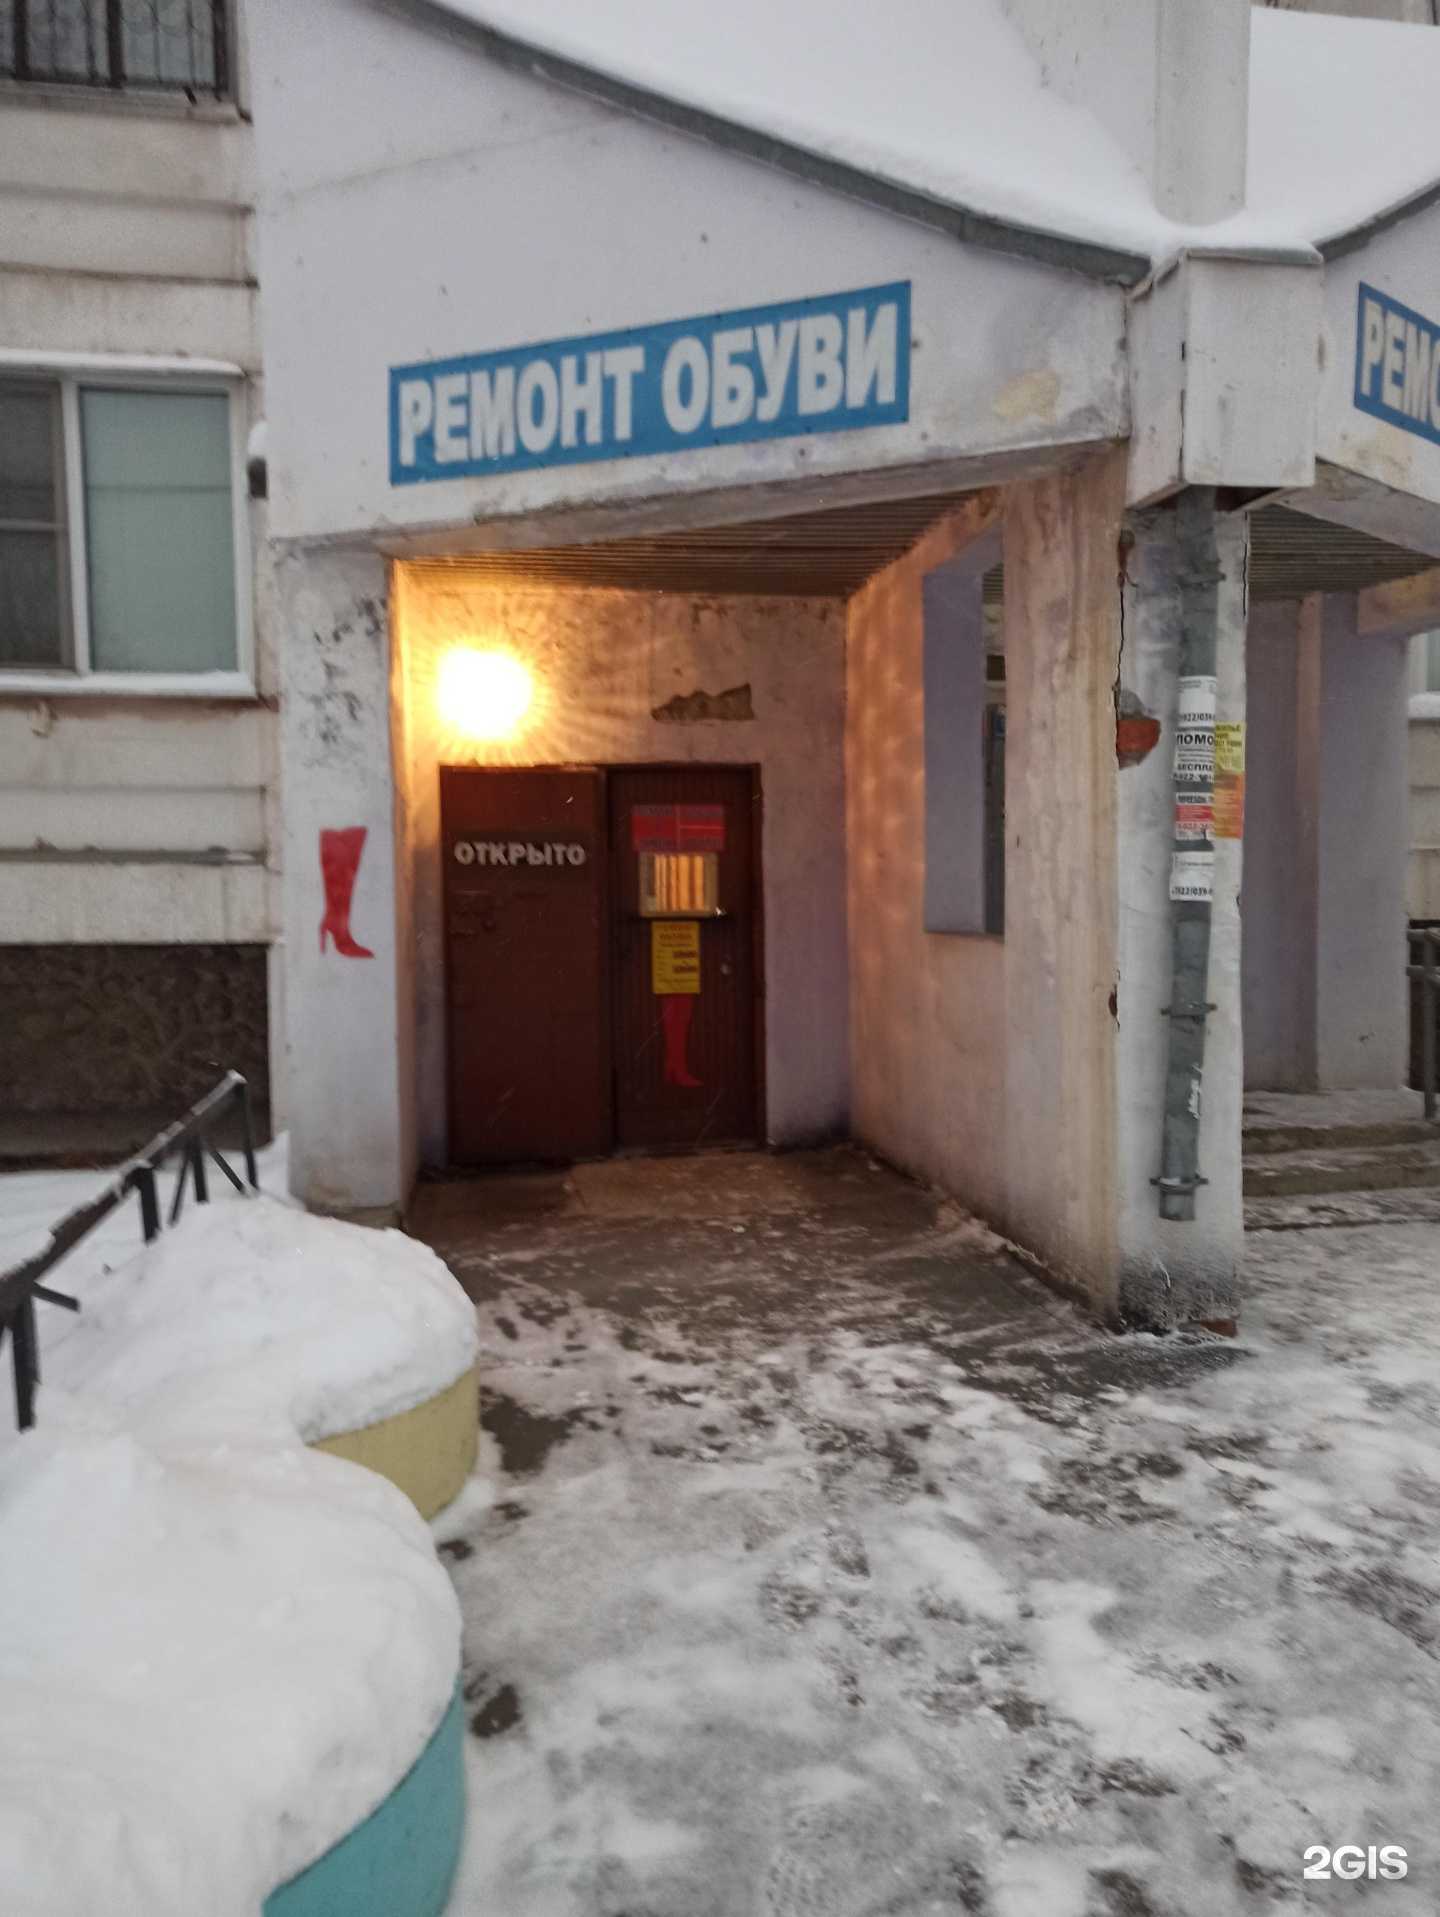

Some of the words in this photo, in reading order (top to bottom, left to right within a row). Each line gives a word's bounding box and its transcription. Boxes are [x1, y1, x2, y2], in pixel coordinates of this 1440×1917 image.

[398, 346, 646, 467] РЕМОНТ
[661, 303, 898, 434] ОБУВИ
[453, 841, 587, 867] ОТКРЫТО
